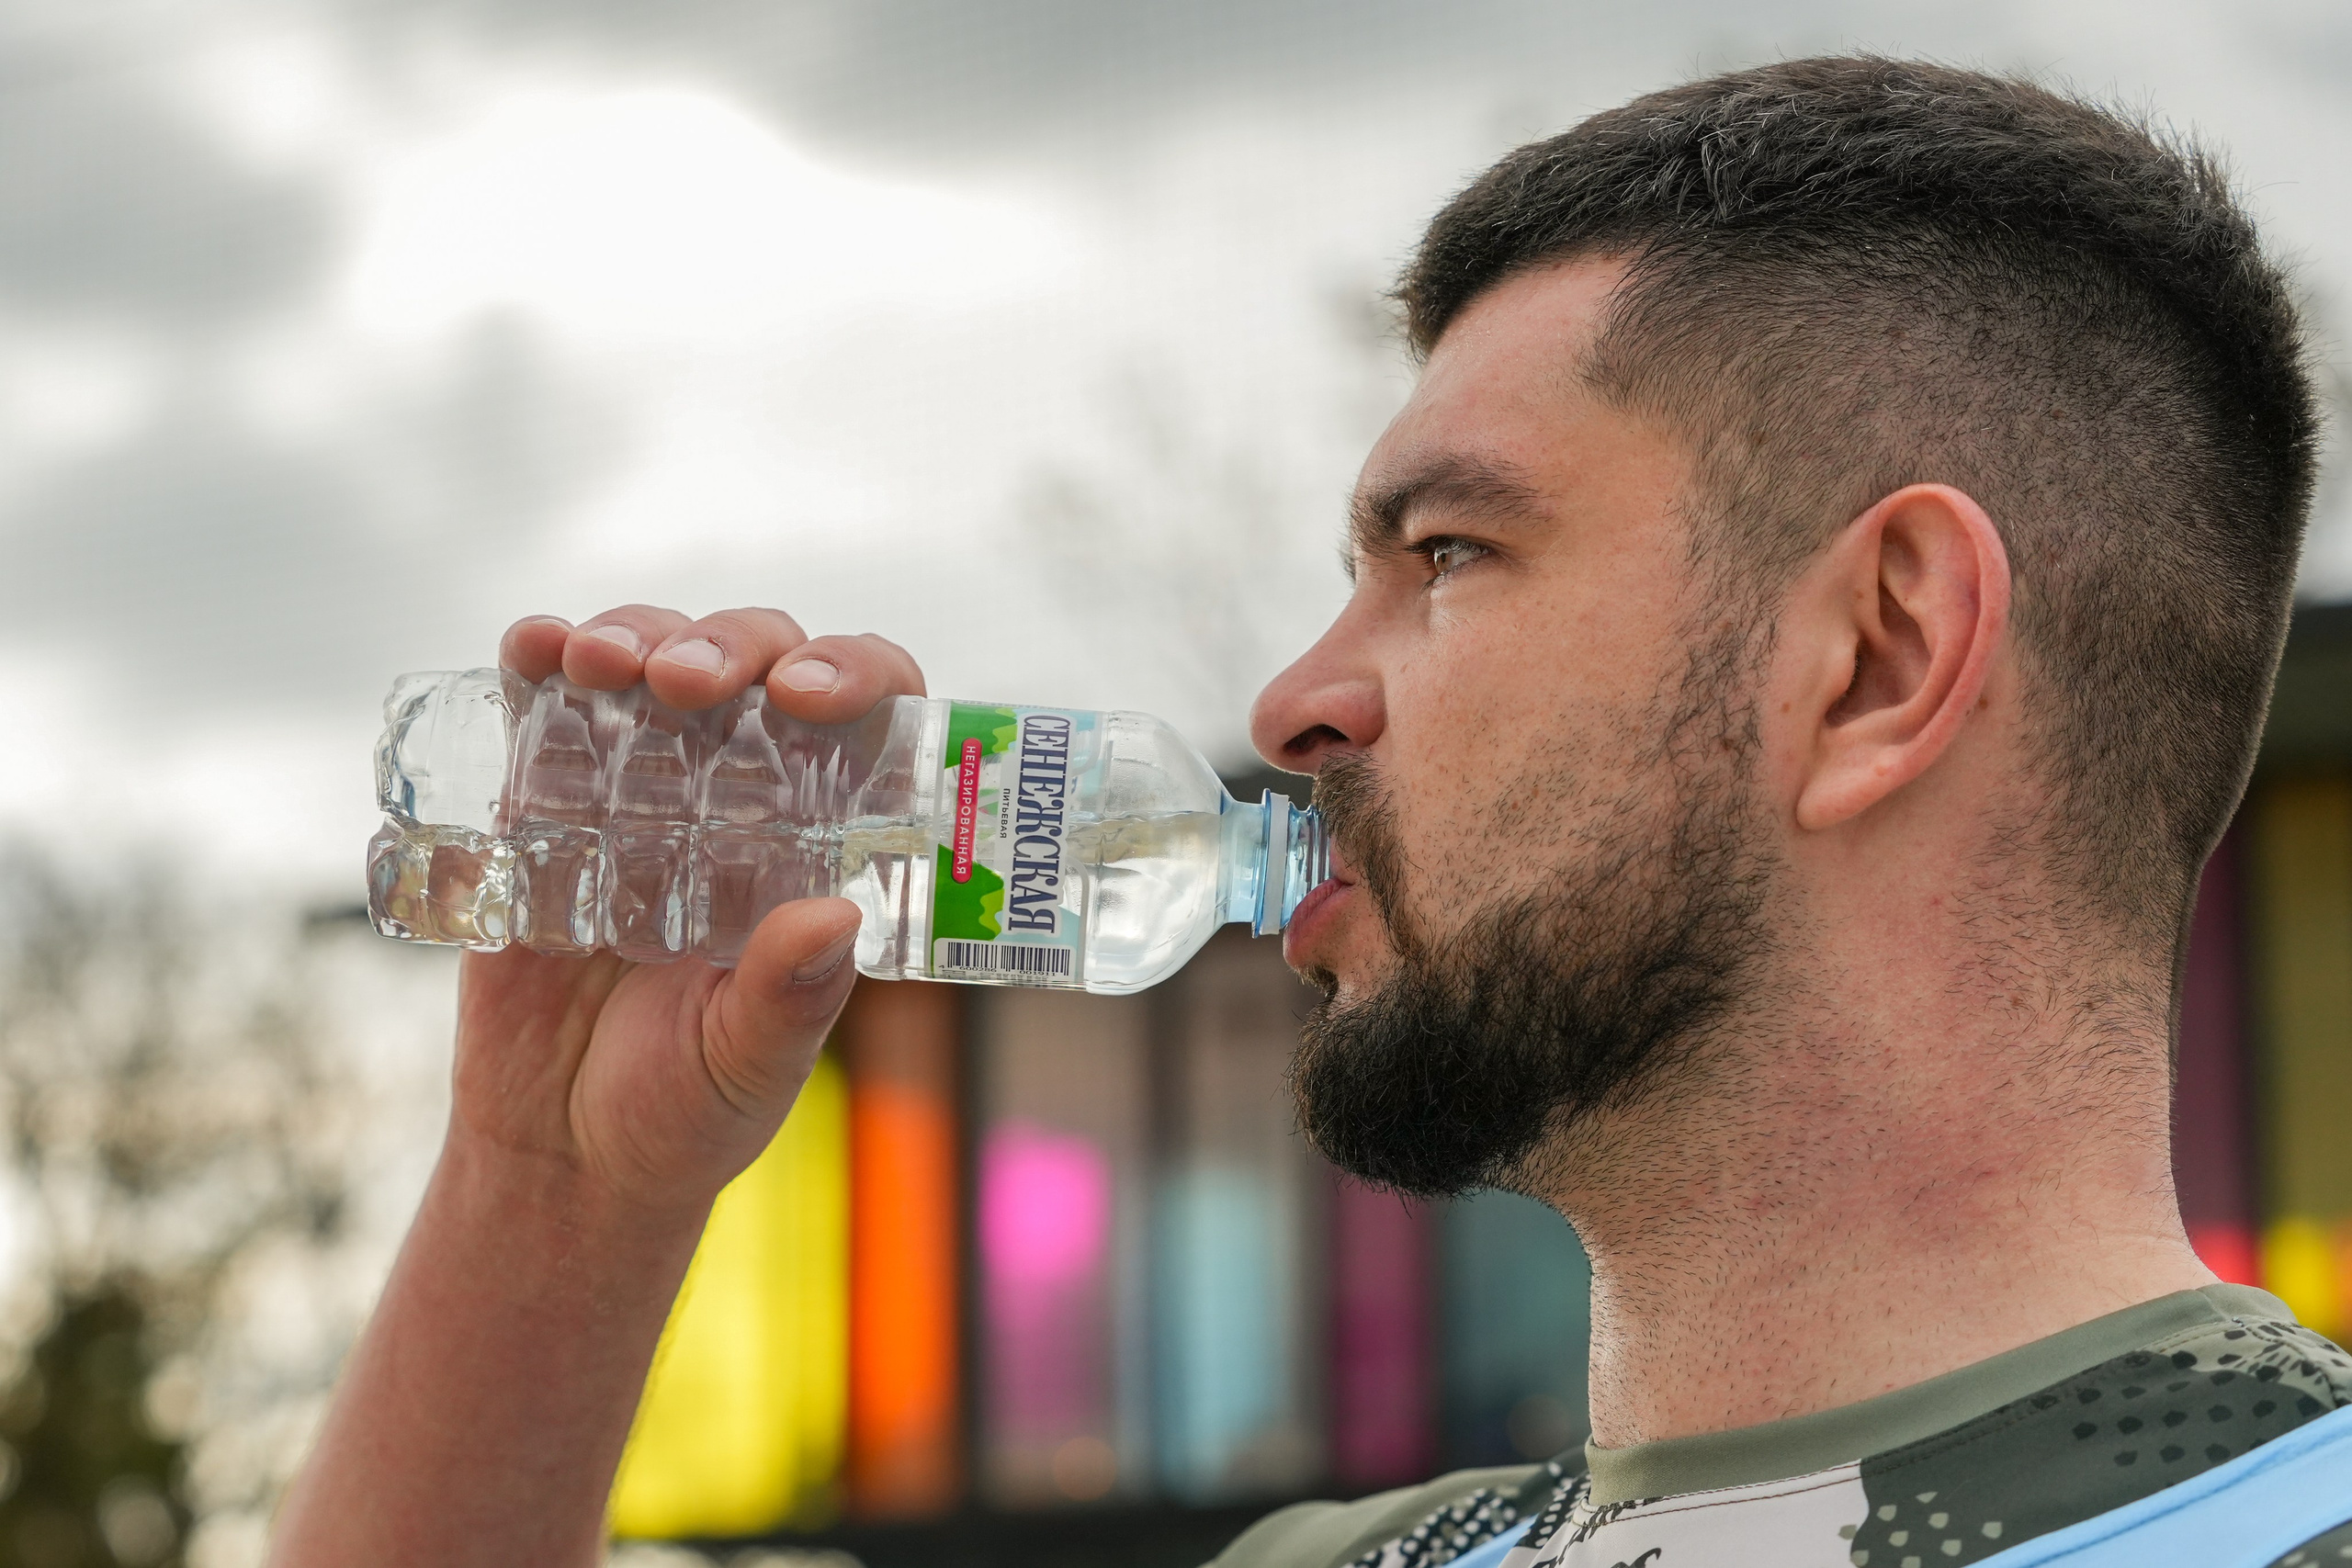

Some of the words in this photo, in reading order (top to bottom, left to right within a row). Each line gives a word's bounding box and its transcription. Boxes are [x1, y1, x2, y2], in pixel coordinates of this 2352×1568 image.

[956, 745, 977, 874] НЕГАЗИРОВАННАЯ
[1000, 788, 1011, 839] ПИТЬЕВАЯ
[1008, 715, 1071, 933] СЕНЕЖСКАЯ
